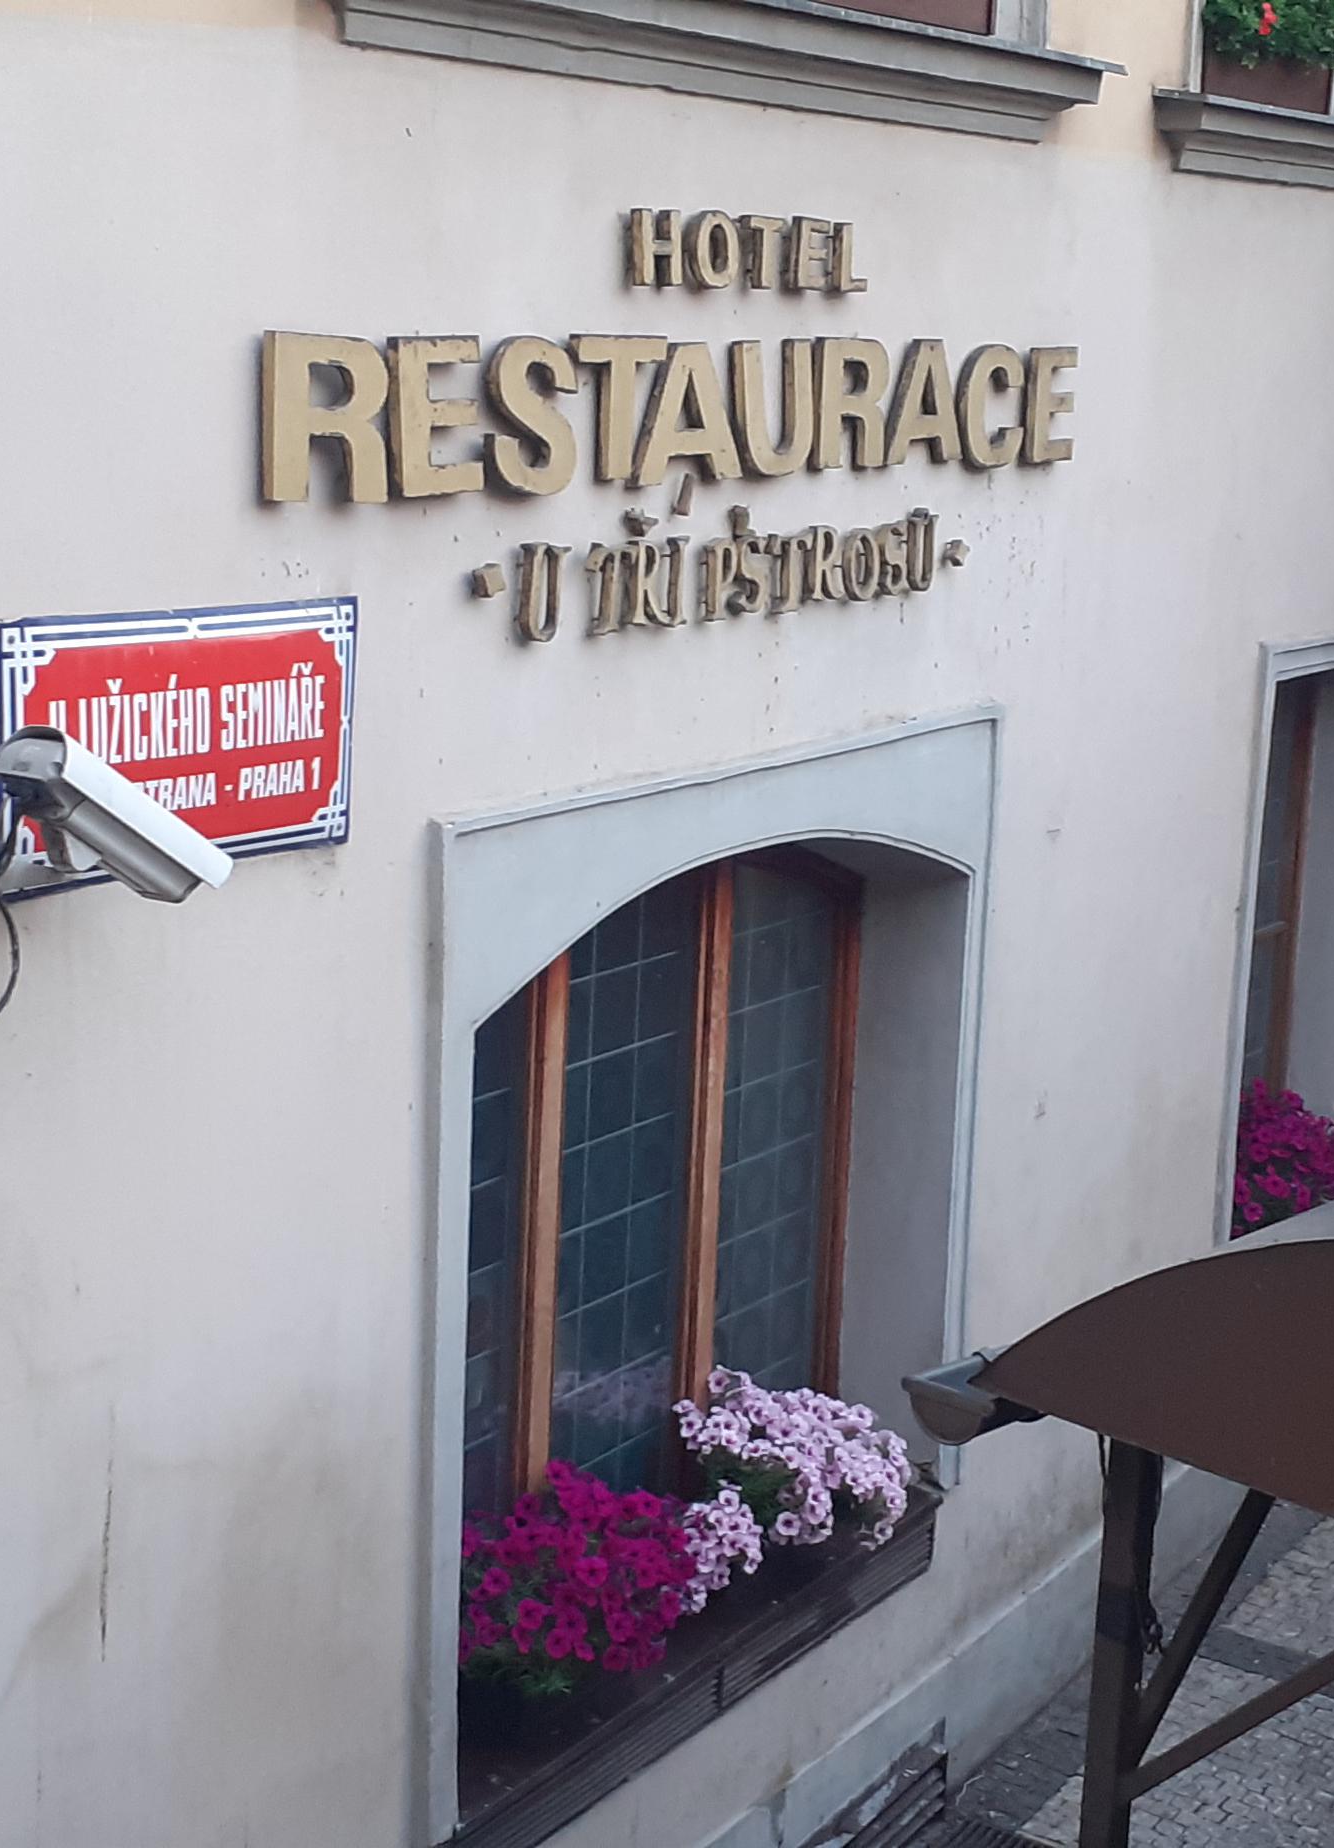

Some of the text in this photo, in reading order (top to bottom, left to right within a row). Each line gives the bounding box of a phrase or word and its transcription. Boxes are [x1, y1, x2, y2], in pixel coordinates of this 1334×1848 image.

[630, 208, 868, 293] HOTEL
[261, 330, 1079, 505] RESTAURACE
[515, 541, 572, 642] U
[220, 661, 326, 751] SEMINÁŘE
[133, 772, 217, 812] TRANA
[238, 759, 305, 801] PRAHA
[311, 757, 322, 790] 1
